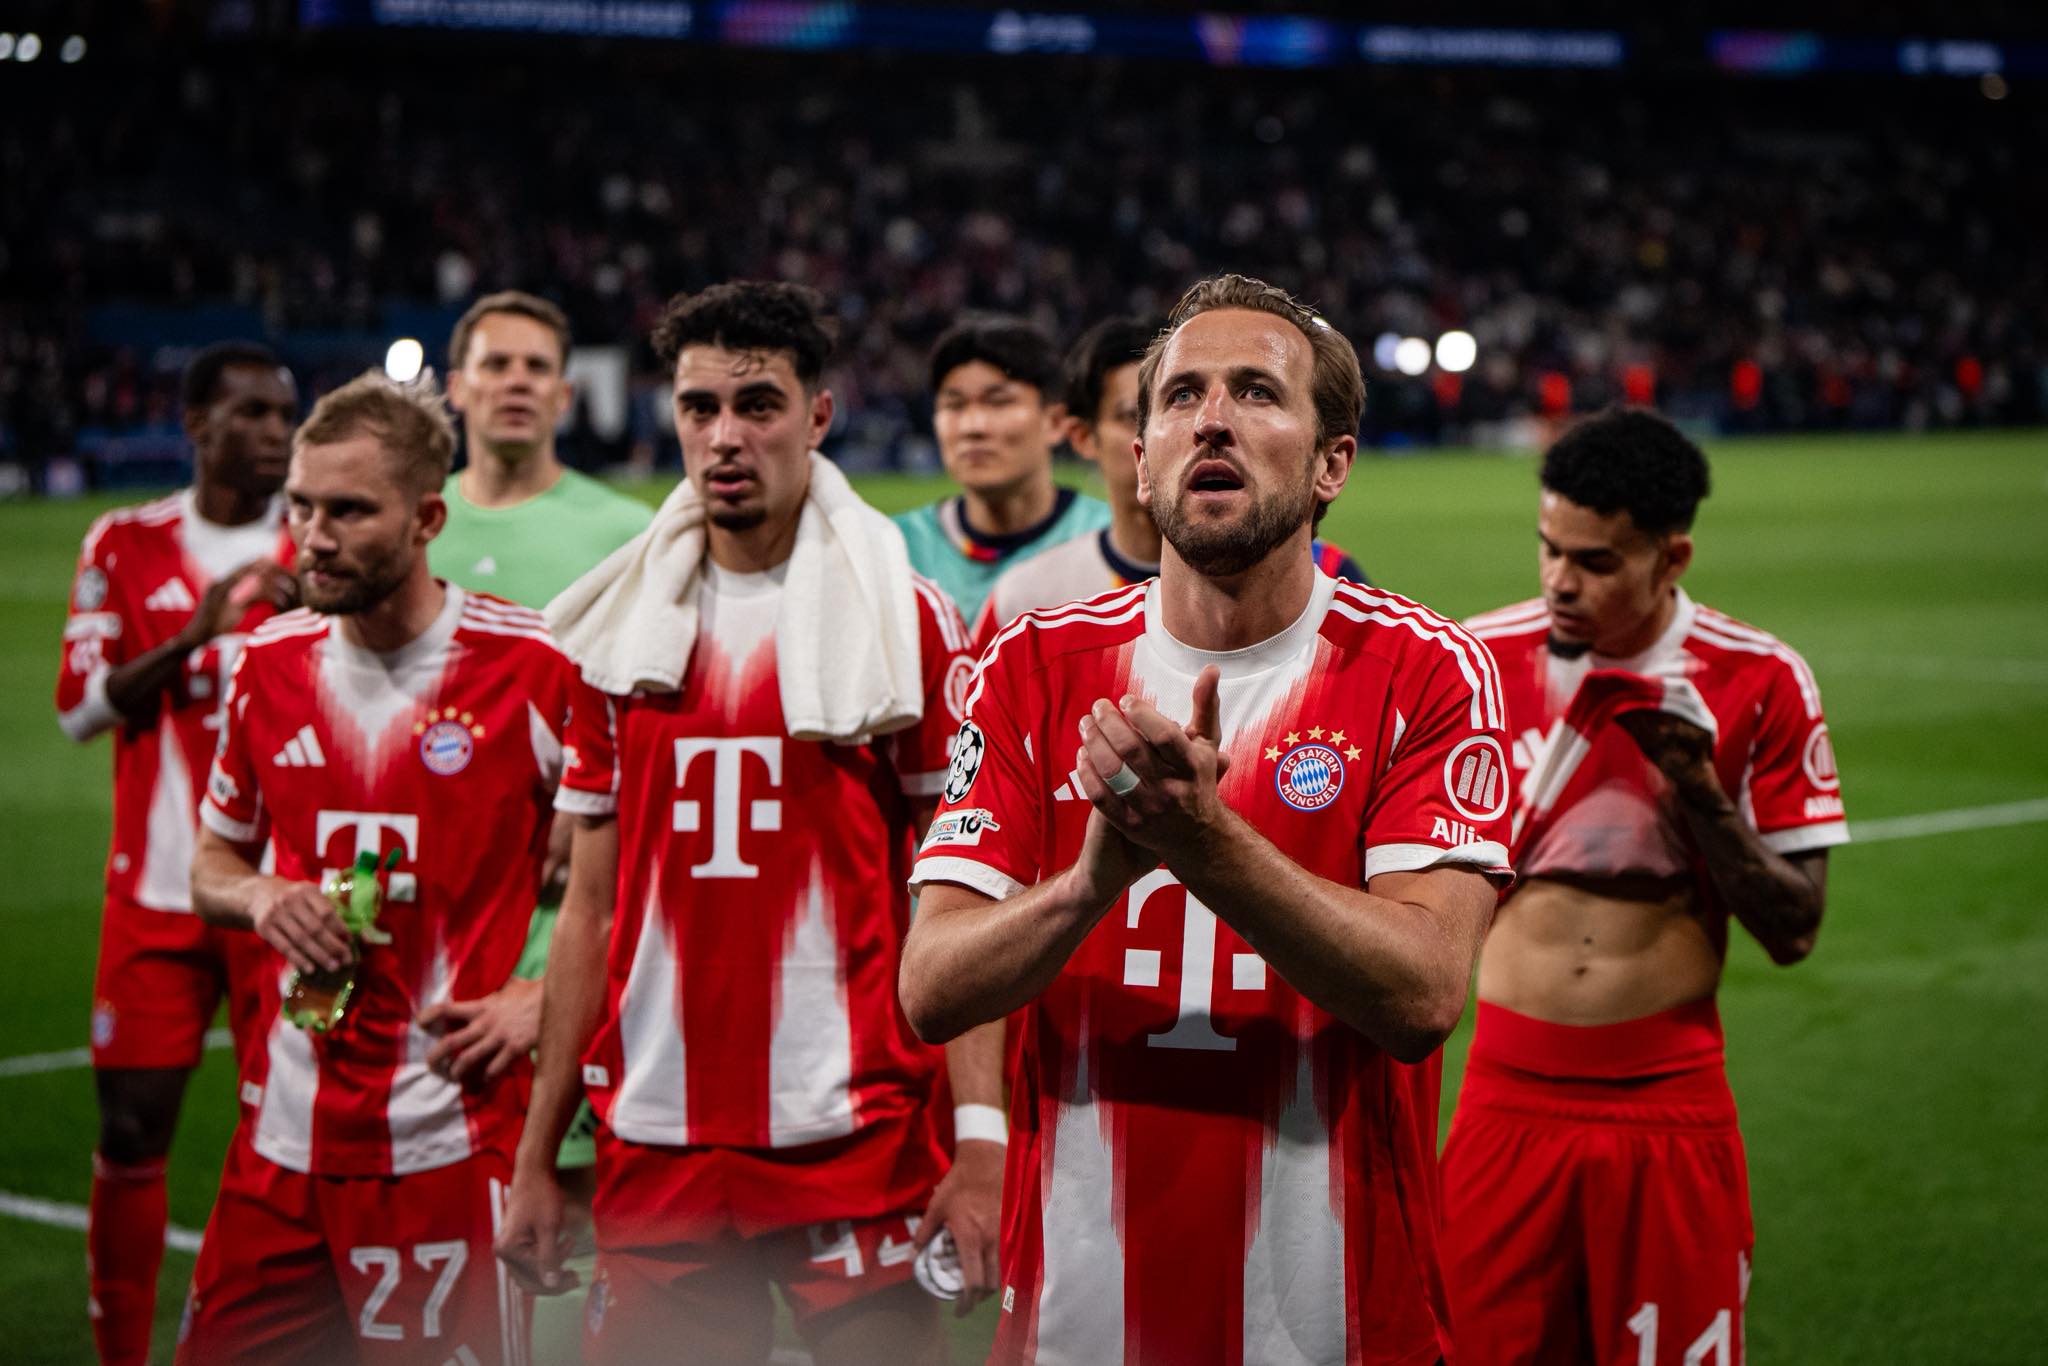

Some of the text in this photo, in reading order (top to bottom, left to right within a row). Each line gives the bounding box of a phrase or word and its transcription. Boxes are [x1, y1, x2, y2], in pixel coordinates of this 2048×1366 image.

[1283, 749, 1340, 773] FC BAYERN
[673, 735, 784, 879] T
[959, 815, 982, 834] 10
[349, 1239, 469, 1341] 27
